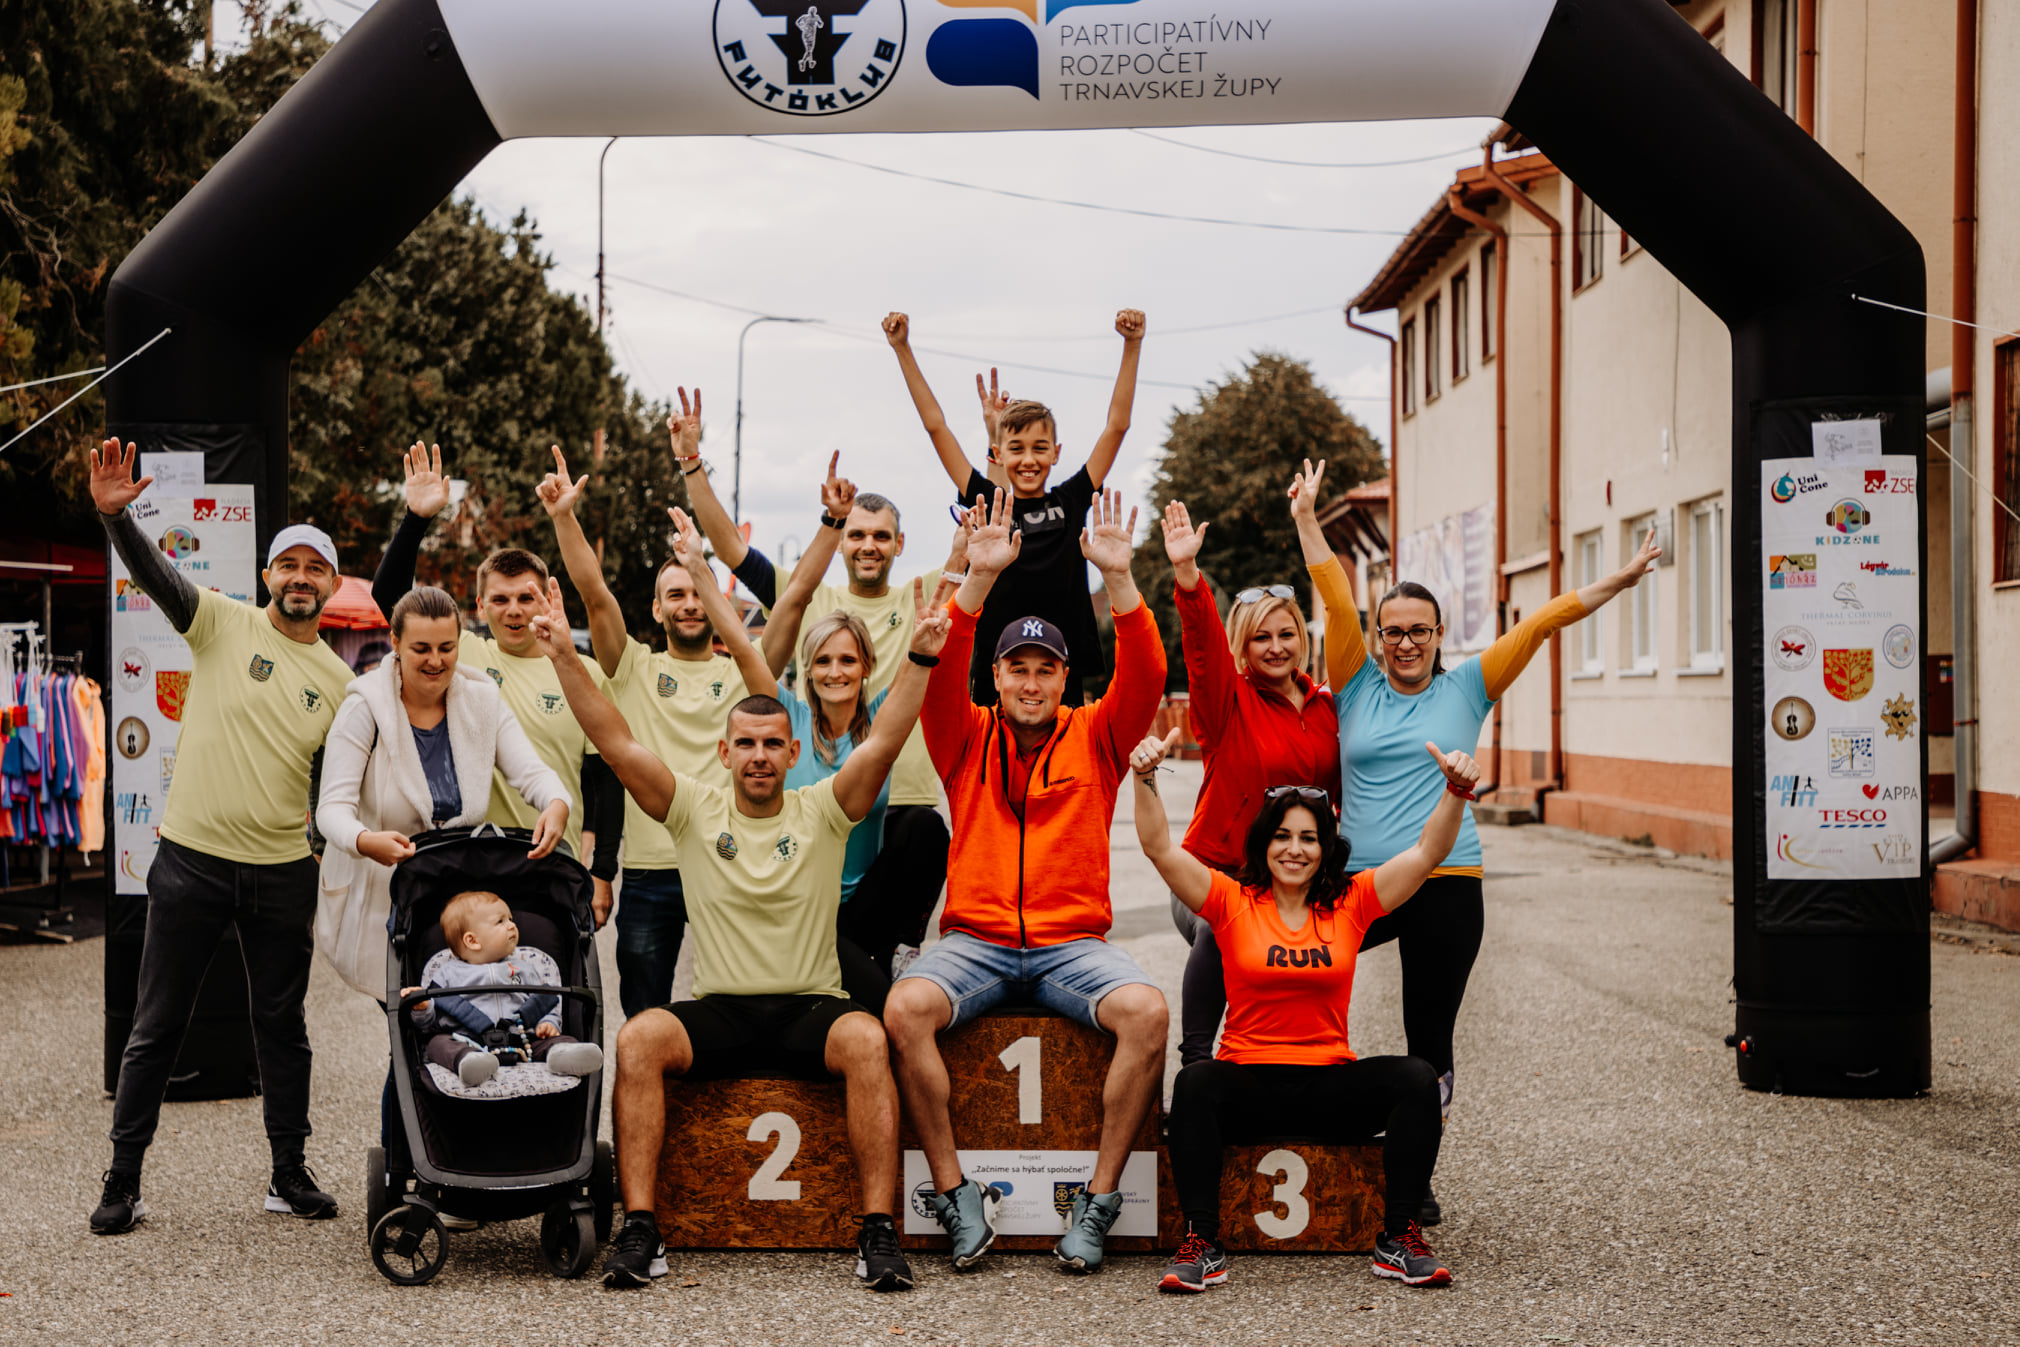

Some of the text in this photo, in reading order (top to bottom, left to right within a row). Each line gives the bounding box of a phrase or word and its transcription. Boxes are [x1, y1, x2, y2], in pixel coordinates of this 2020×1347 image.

[1060, 13, 1273, 47] PARTICIPATÍVNY
[1060, 46, 1208, 77] ROZPOČET
[1059, 72, 1282, 101] TRNAVSKEJ ŽUPY
[1797, 474, 1819, 486] Uni
[1799, 480, 1829, 494] Cone
[1890, 477, 1915, 494] ZSE
[135, 501, 152, 511] Uni
[137, 508, 160, 520] Cone
[221, 506, 252, 522] ZSE
[1023, 505, 1065, 525] UN
[1022, 619, 1043, 637] NY
[1882, 786, 1918, 801] APPA
[1818, 809, 1887, 822] TESCO
[1873, 842, 1912, 864] VIP
[1266, 944, 1333, 969] RUN
[997, 1036, 1041, 1125] 1
[747, 1112, 800, 1201] 2
[1253, 1149, 1310, 1240] 3
